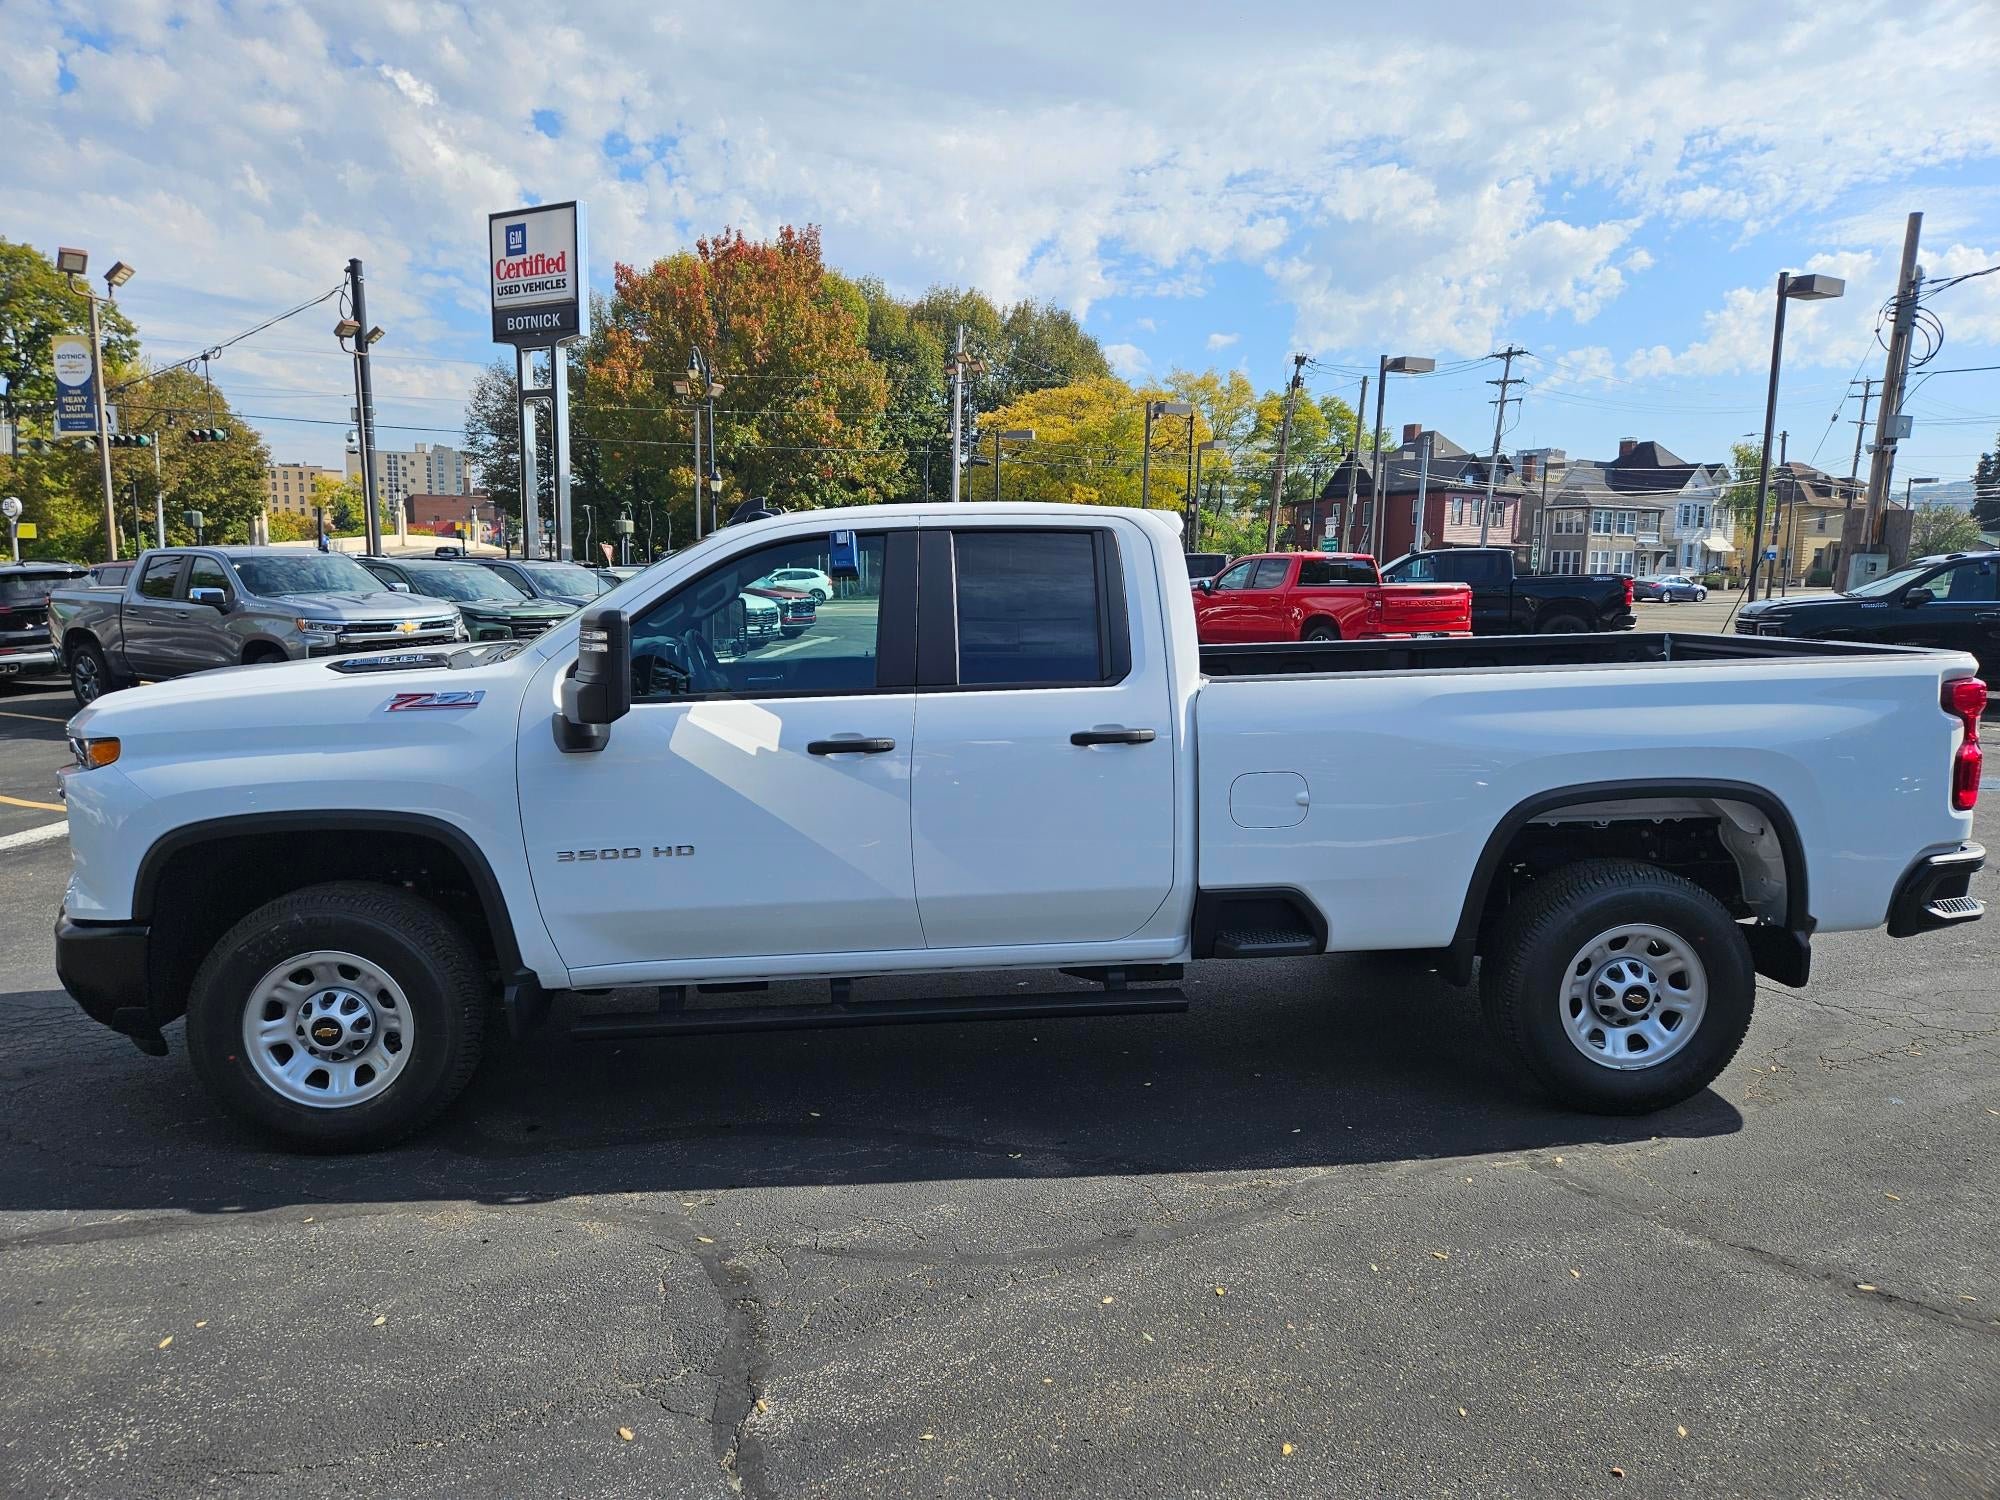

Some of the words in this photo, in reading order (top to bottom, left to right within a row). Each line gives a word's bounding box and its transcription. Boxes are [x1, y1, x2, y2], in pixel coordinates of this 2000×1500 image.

[509, 230, 522, 245] GM
[495, 250, 567, 281] Certified
[497, 284, 521, 297] USED
[522, 278, 567, 294] VEHICLES
[507, 312, 561, 331] BOTNICK
[62, 396, 88, 404] HEAVY
[65, 404, 87, 412] DUTY
[1389, 599, 1464, 608] CHEVROLET
[384, 690, 487, 712] Z71
[556, 847, 642, 862] 3500
[652, 845, 695, 858] HD
